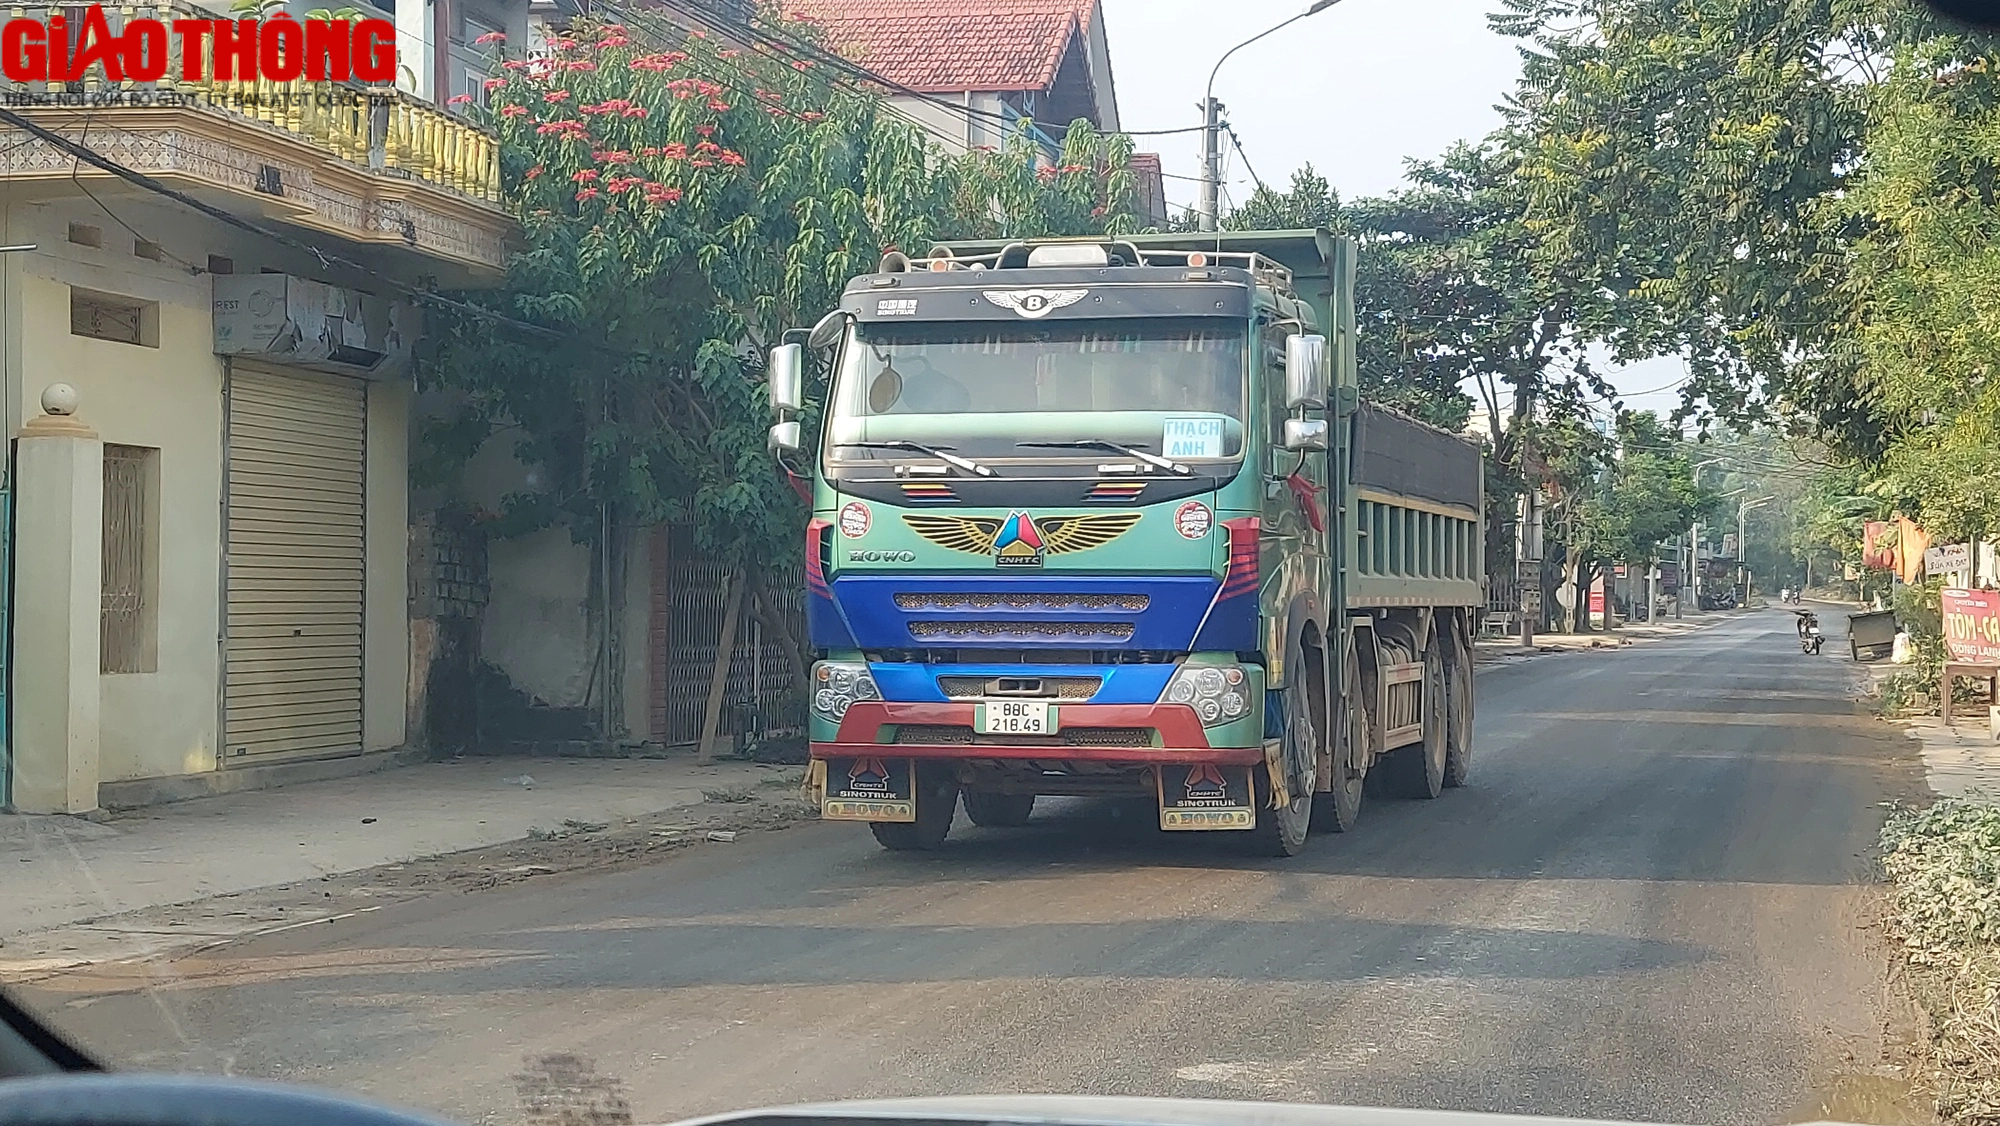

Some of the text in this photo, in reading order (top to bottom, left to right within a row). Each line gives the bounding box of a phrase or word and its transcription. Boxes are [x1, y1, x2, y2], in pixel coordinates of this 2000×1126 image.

[1164, 421, 1220, 438] THẠCH
[1171, 441, 1205, 456] ANH
[849, 550, 916, 563] HOWO
[998, 556, 1040, 564] CNHTC
[1003, 703, 1030, 716] 88C
[992, 718, 1041, 731] 218.49
[839, 790, 897, 799] SINOTRUK
[1176, 799, 1237, 807] SINOTRUK
